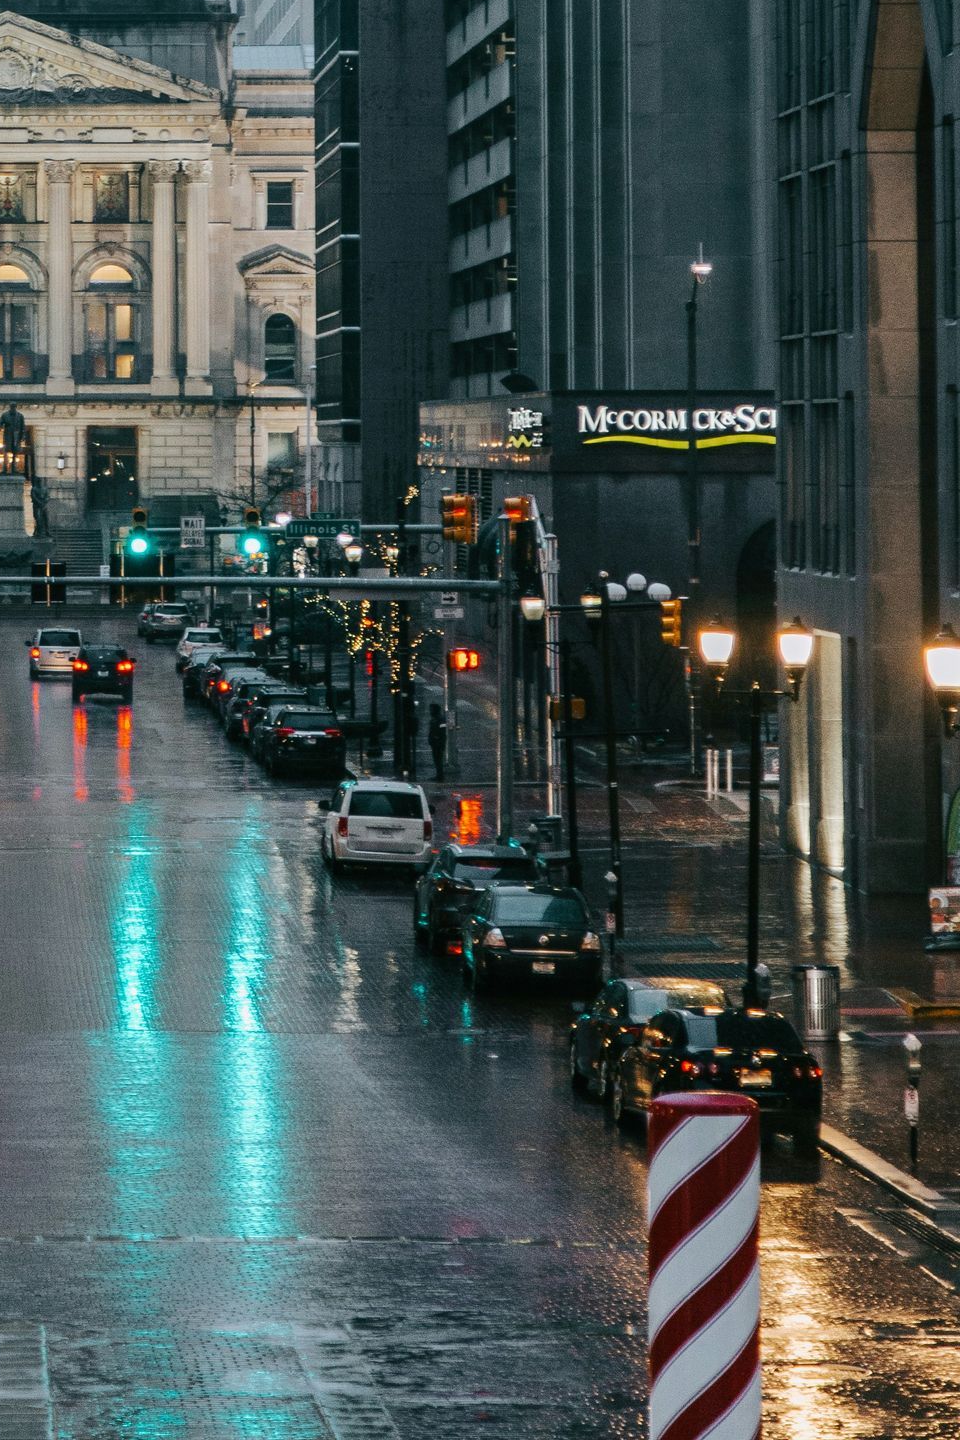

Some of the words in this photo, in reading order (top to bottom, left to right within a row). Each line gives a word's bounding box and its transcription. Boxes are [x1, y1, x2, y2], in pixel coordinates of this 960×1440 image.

[184, 519, 203, 529] WAIT
[290, 524, 337, 534] Illinois
[342, 524, 356, 534] St
